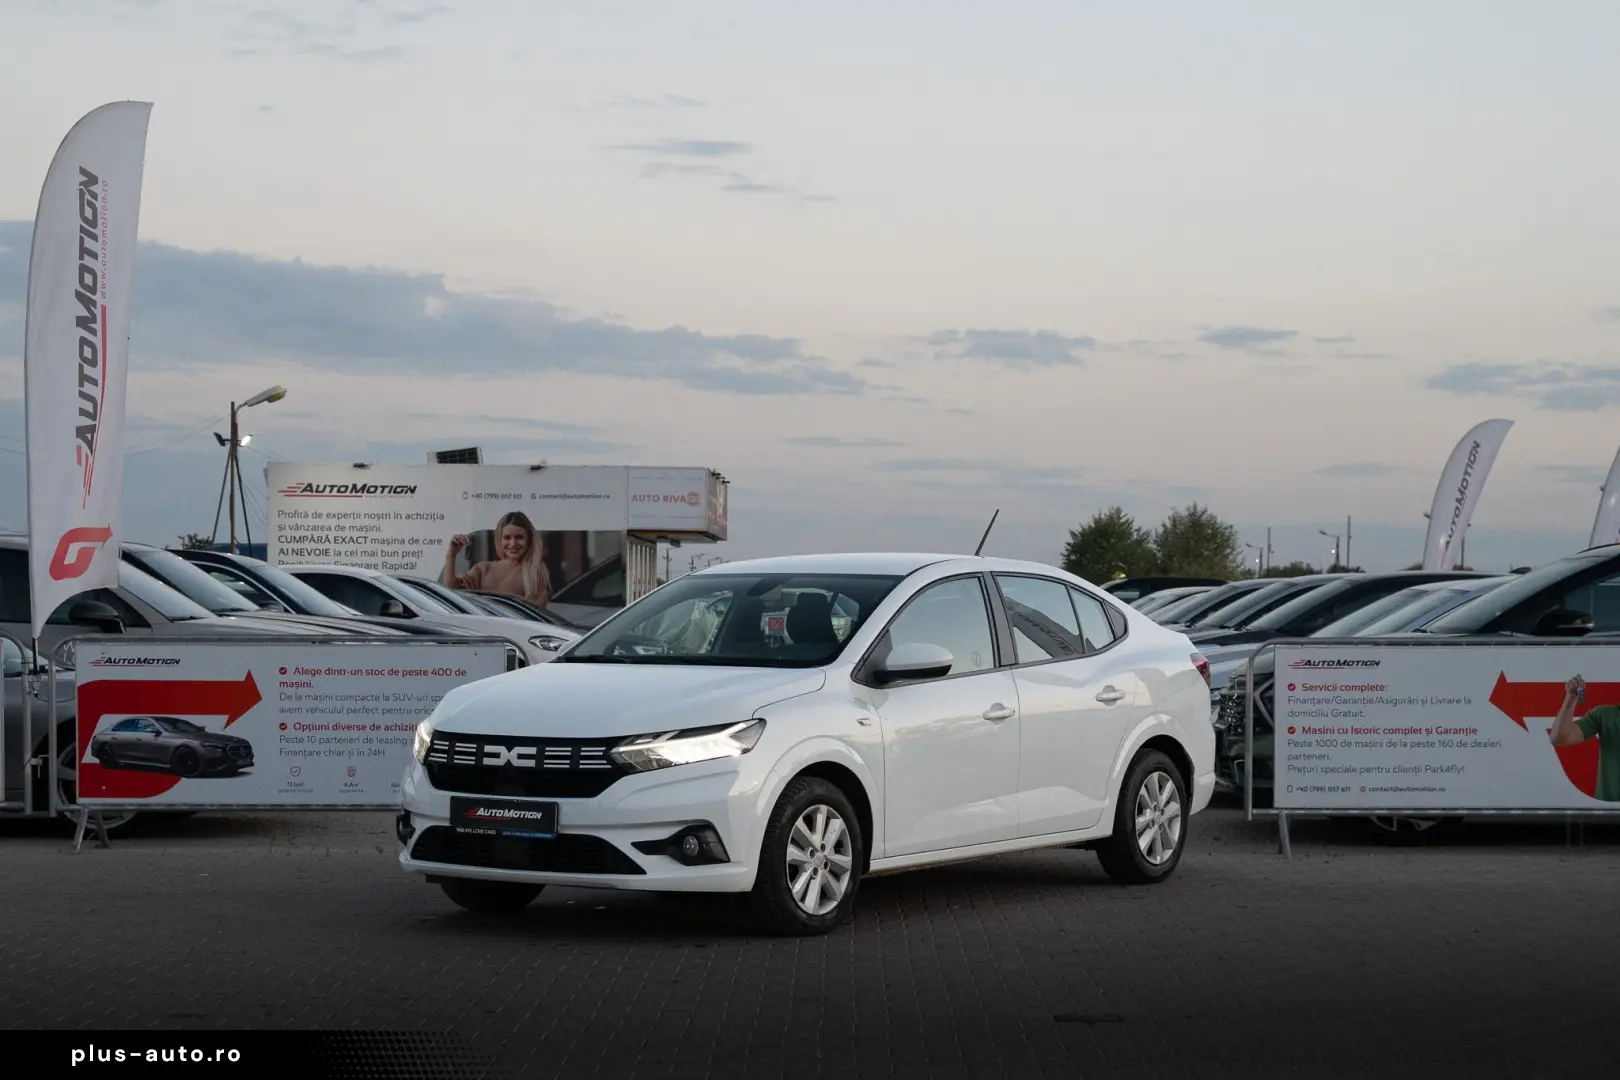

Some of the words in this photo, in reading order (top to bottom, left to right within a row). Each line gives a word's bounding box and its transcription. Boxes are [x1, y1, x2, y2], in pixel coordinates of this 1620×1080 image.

[100, 180, 108, 300] www.automotion.ro
[631, 494, 660, 503] AUTO
[277, 510, 309, 519] Profită
[311, 510, 323, 519] de
[326, 511, 361, 522] experții
[363, 511, 391, 521] noștri
[394, 511, 402, 520] în
[404, 511, 445, 522] achiziția
[277, 523, 286, 532] și
[288, 523, 332, 532] vânzarea
[334, 523, 346, 532] de
[348, 524, 383, 534] mașini.
[277, 534, 331, 544] CUMPĂRĂ
[333, 536, 368, 545] EXACT
[370, 537, 405, 547] mașina
[407, 536, 420, 545] de
[277, 548, 289, 557] AI
[291, 548, 331, 557] NEVOIE
[333, 548, 342, 557] la
[344, 548, 358, 557] cel
[361, 549, 378, 557] mai
[381, 549, 399, 558] bun
[401, 549, 423, 559] preț!
[381, 561, 417, 571] Rapidă!
[293, 667, 322, 677] Alege
[324, 667, 363, 676] dintr-un
[365, 668, 385, 677] stoc
[388, 668, 400, 677] de
[402, 668, 428, 678] peste
[430, 668, 453, 677] 400
[454, 668, 467, 677] de
[279, 680, 314, 690] mașini.
[1302, 683, 1337, 692] Servicii
[1339, 683, 1388, 694] complete:
[279, 693, 293, 702] De
[295, 693, 302, 702] la
[335, 693, 380, 704] compacte
[382, 693, 390, 702] la
[392, 693, 428, 702] SUV-uri
[1421, 697, 1428, 707] și
[1430, 697, 1461, 705] Livrare
[1464, 697, 1472, 705] la
[305, 705, 344, 714] vehiculul
[346, 705, 379, 716] perfect
[381, 706, 412, 716] pentru
[1287, 709, 1329, 718] domiciliu
[1331, 709, 1367, 718] Gratuit.
[293, 722, 330, 732] Opțiuni
[331, 722, 367, 731] diverse
[369, 722, 381, 731] de
[383, 723, 418, 733] achiziți
[1351, 726, 1381, 735] Istoric
[1383, 726, 1422, 737] complet
[1425, 726, 1433, 736] și
[1435, 726, 1478, 736] Garanție
[279, 736, 304, 744] Peste
[306, 736, 317, 744] 10
[319, 736, 360, 747] parteneri
[362, 736, 374, 744] de
[376, 736, 408, 747] leasing
[1287, 739, 1313, 747] Peste
[1315, 739, 1338, 747] 1000
[1340, 739, 1352, 747] de
[1355, 739, 1383, 750] mașini
[1386, 739, 1398, 748] de
[1400, 739, 1408, 748] la
[1410, 740, 1436, 750] peste
[1438, 740, 1453, 748] 160
[1456, 740, 1468, 748] de
[1470, 739, 1502, 748] dealeri
[279, 748, 322, 759] Finanțare
[323, 748, 345, 757] chiar
[347, 748, 353, 759] și
[366, 748, 386, 757] 24H
[1287, 752, 1332, 762] parteneri.
[1287, 765, 1319, 775] Prețuri
[1320, 765, 1358, 775] speciale
[1360, 765, 1391, 776] pentru
[1392, 764, 1423, 776] clienții
[1425, 764, 1465, 775] Park4fly!
